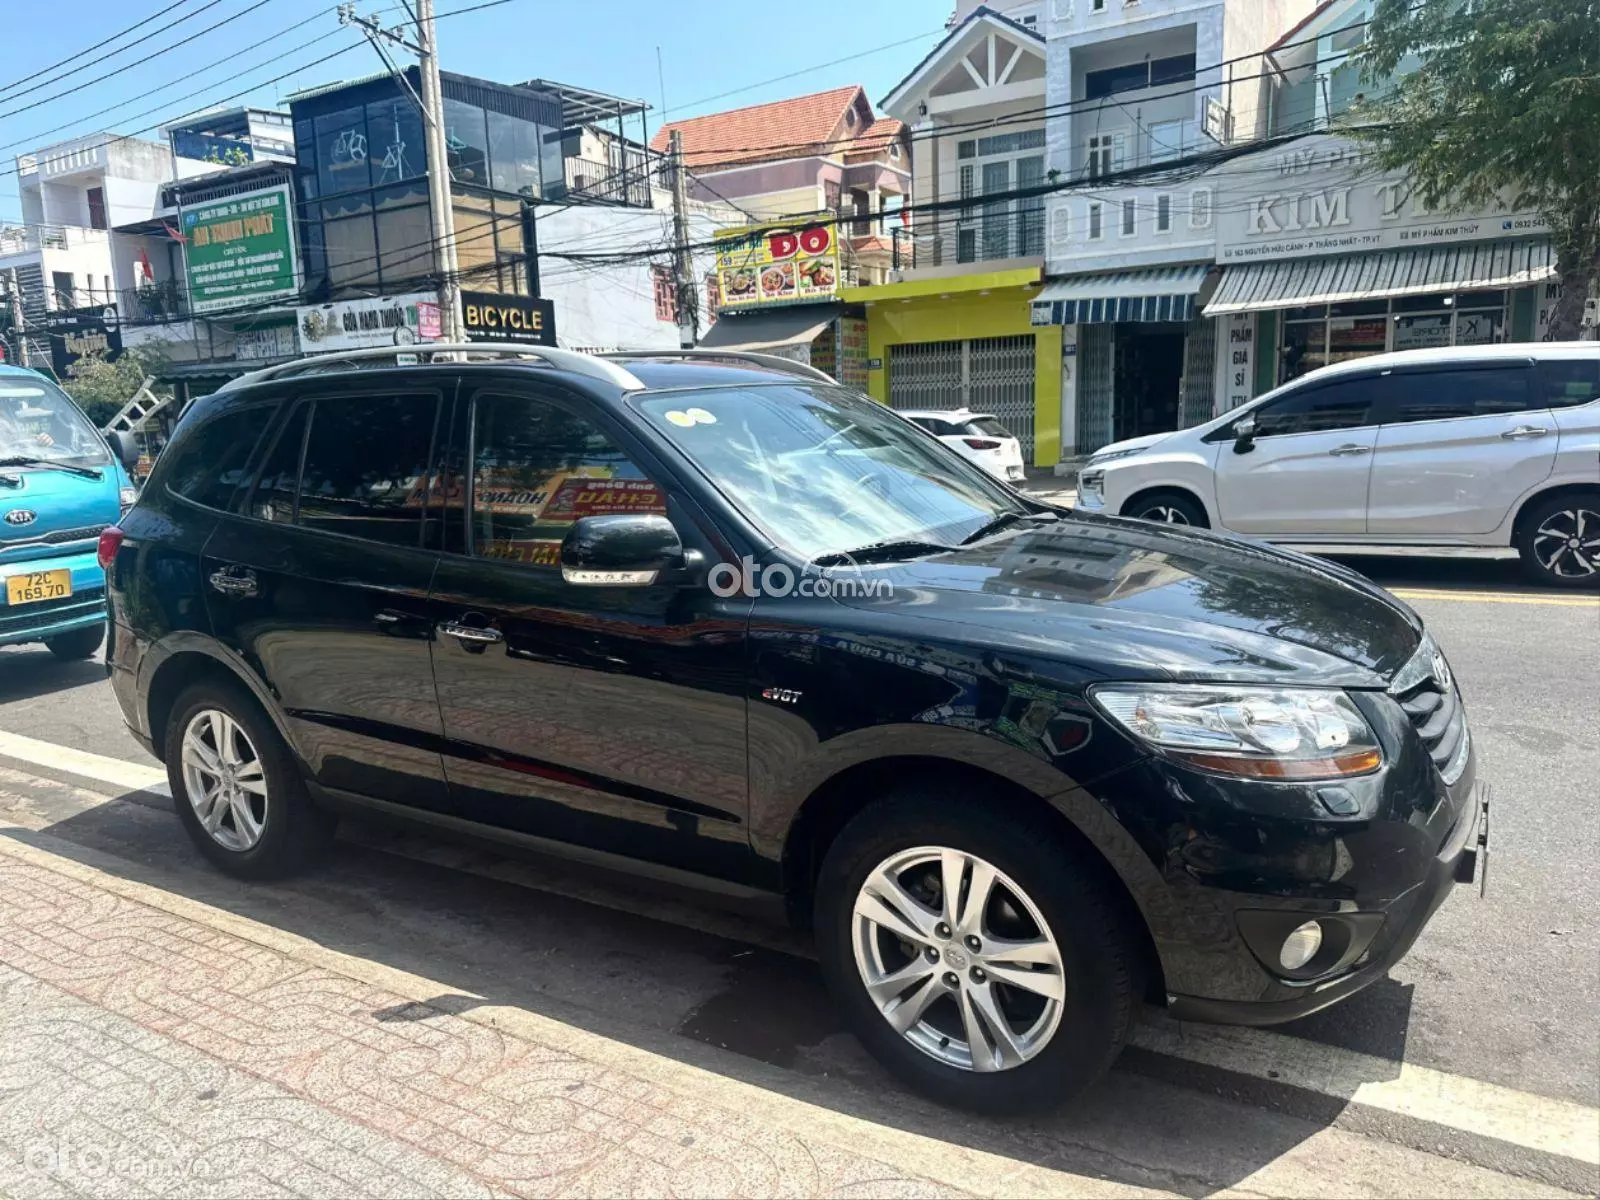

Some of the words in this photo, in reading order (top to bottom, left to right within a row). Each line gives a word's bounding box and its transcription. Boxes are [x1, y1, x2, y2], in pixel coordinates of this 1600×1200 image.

[1247, 187, 1351, 235] KIM
[466, 304, 544, 330] BICYCLE
[8, 511, 35, 524] KIA
[25, 573, 52, 586] 72C
[16, 584, 65, 602] 169.70
